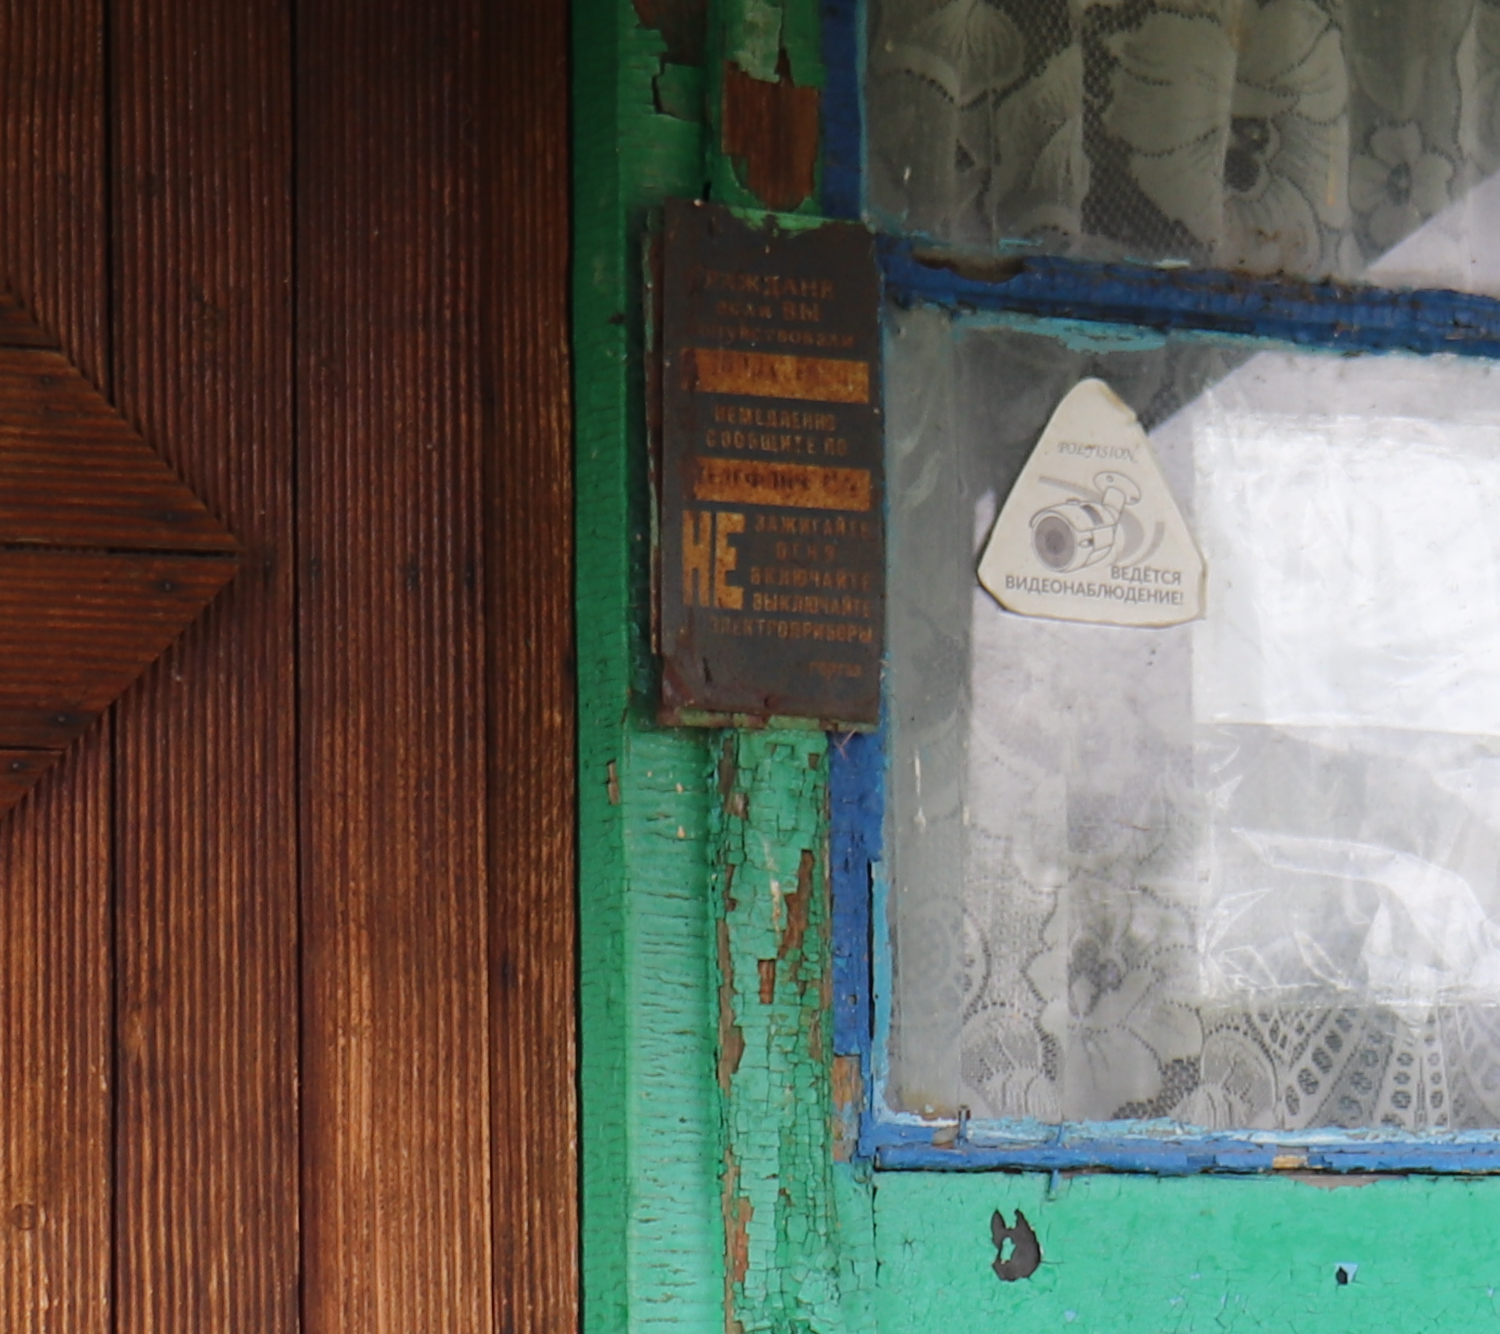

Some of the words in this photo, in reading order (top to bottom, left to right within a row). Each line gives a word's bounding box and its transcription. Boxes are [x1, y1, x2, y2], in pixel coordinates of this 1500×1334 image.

[714, 404, 836, 432] НЕМЕДЛЕННО
[705, 428, 817, 455] СООБЩИТЕ
[823, 437, 848, 457] ПО
[754, 514, 873, 539] ЗАЖИГАЙТЕ
[681, 509, 746, 611] НЕ
[750, 566, 873, 591] ВКЛЮЧАЙТЕ
[1110, 564, 1182, 585] ВЕДЁТСЯ
[1005, 574, 1185, 606] ВИДЕОНАБЛЮДЕНИЕ!
[752, 592, 873, 618] ВЫКЛЮЧАЙТЕ
[709, 616, 874, 644] ЭЛЕКТРОПРИБОРЫ
